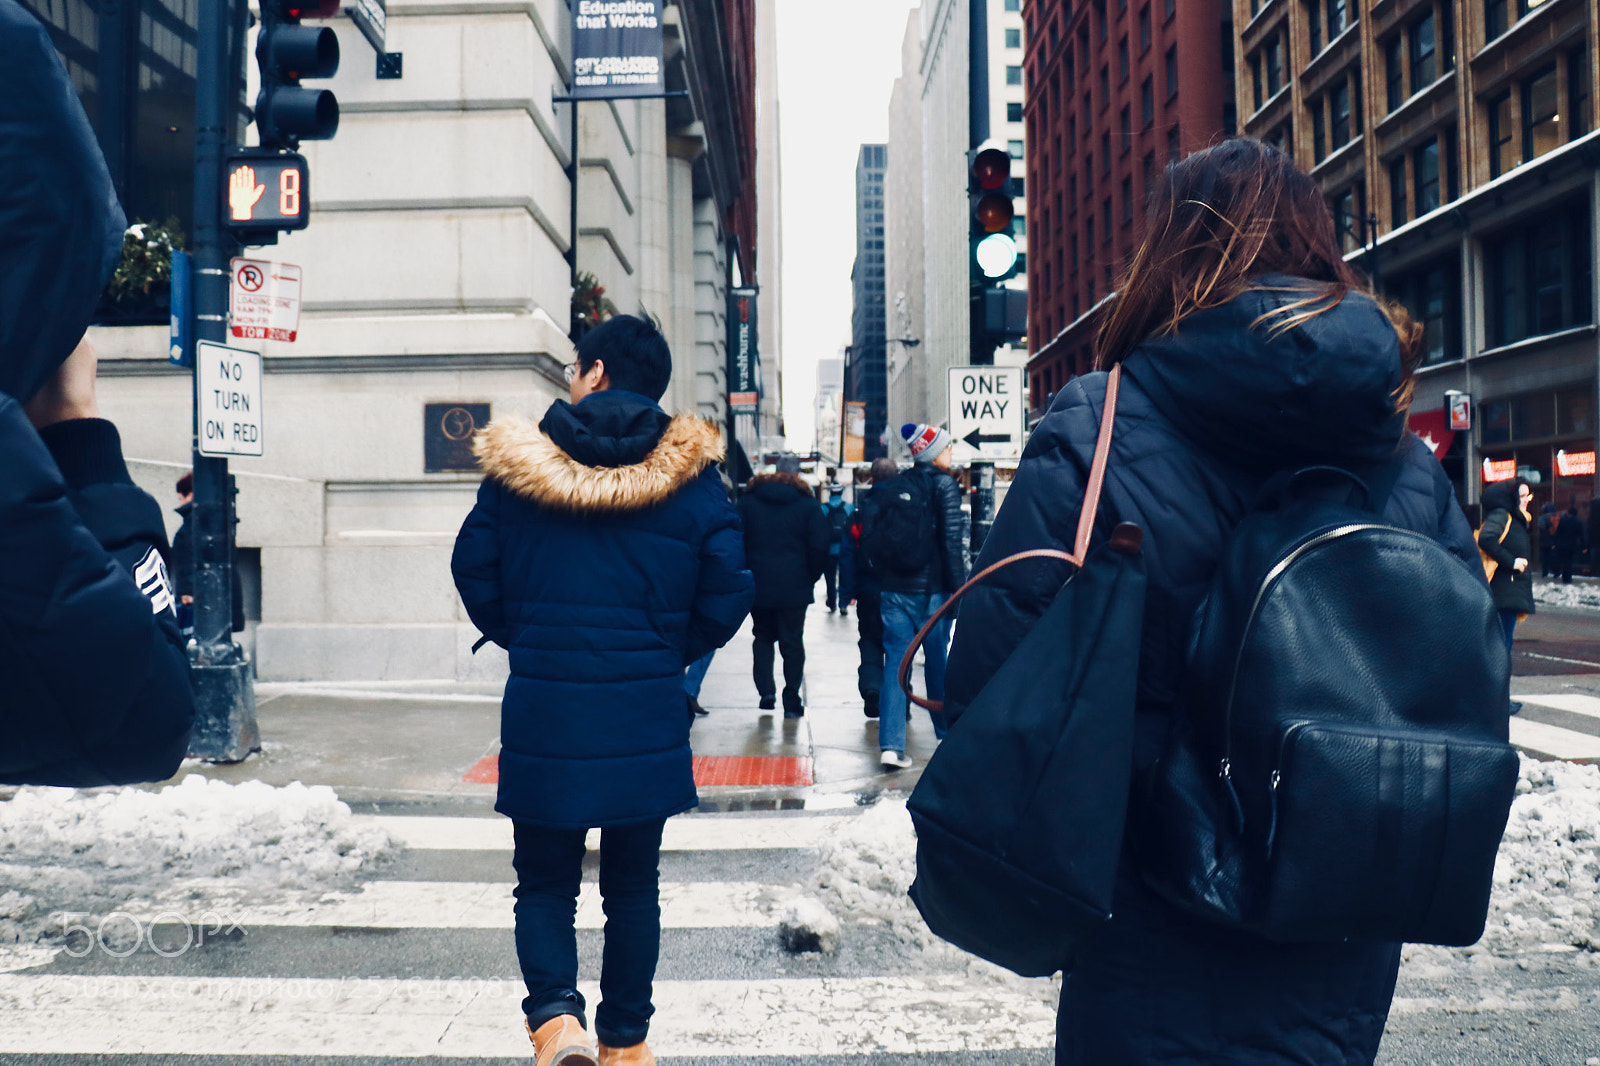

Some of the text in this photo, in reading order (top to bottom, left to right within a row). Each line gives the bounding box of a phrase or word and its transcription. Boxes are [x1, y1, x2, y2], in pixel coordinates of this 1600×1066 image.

[579, 0, 655, 15] Education
[576, 14, 658, 29] that Works
[279, 168, 300, 216] 8
[241, 327, 290, 341] TOW ZONE
[220, 360, 242, 381] NO
[962, 375, 1008, 394] ONE
[214, 389, 250, 412] TURN
[961, 400, 1009, 419] WAY
[206, 420, 258, 443] ON RED
